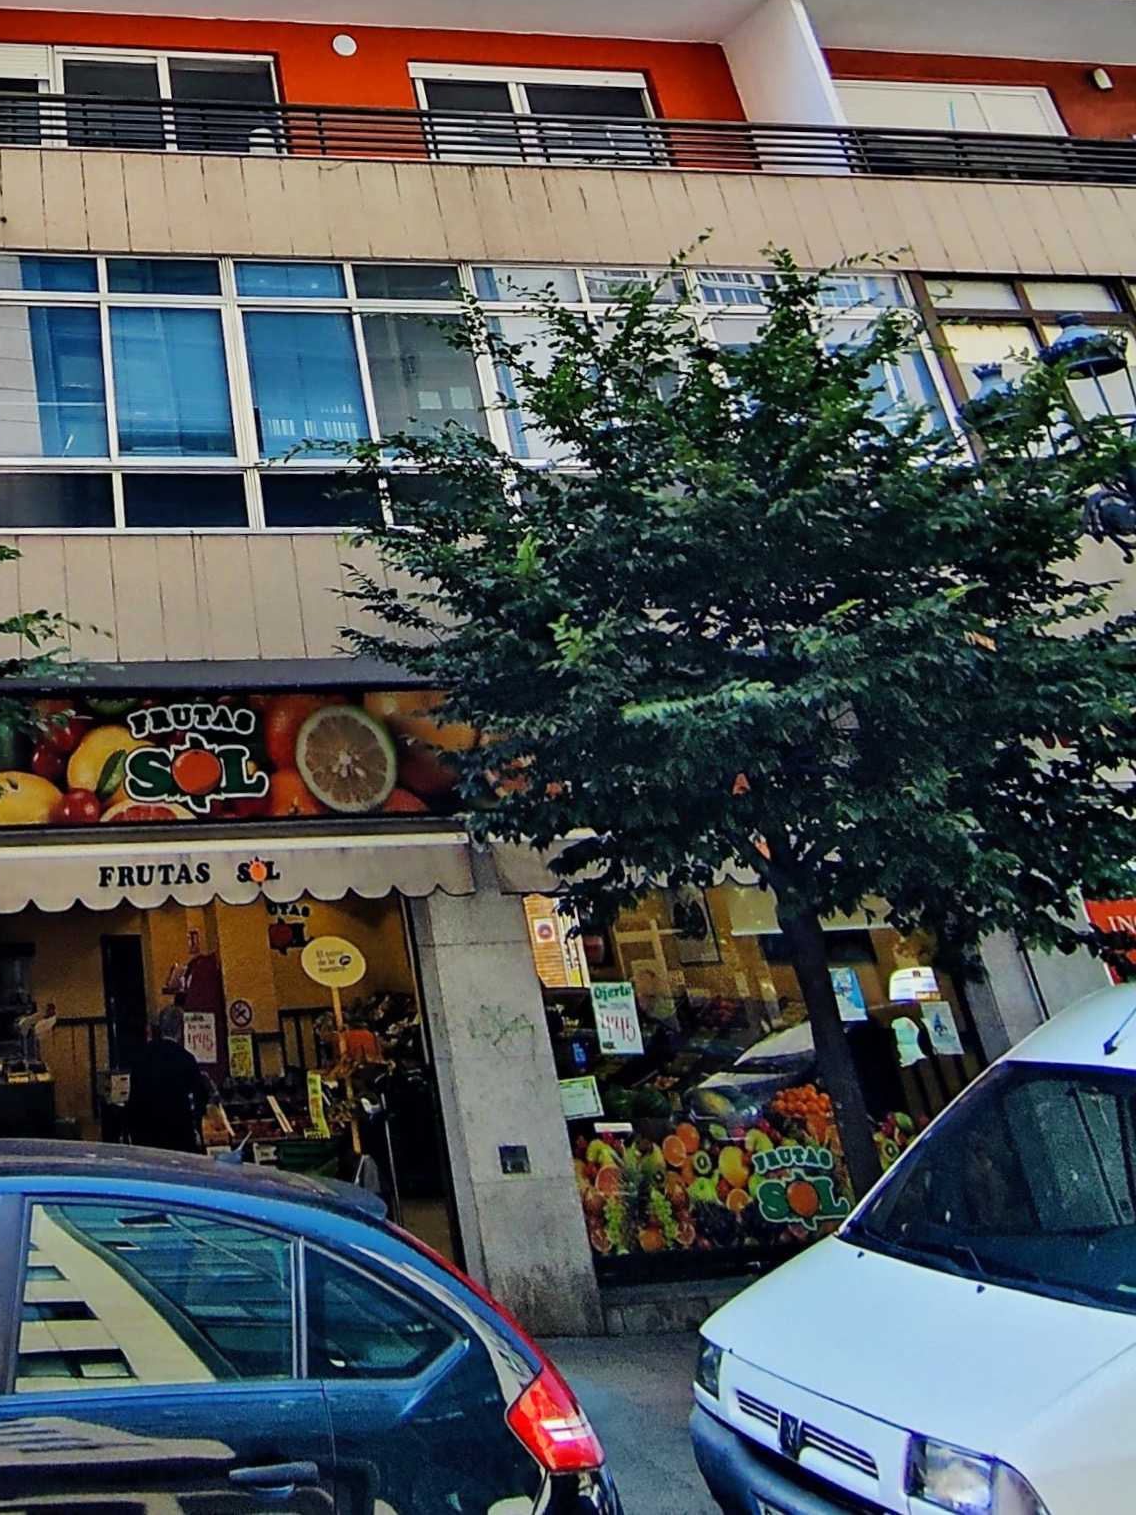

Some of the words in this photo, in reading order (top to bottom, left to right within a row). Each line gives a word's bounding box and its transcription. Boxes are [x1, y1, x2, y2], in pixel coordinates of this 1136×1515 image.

[127, 704, 255, 738] FRUTAS
[125, 736, 269, 811] SOL
[99, 863, 210, 887] FRUTAS
[237, 858, 281, 885] SOL
[267, 903, 310, 918] UTAS
[1107, 915, 1136, 935] IN
[752, 1146, 833, 1174] FRUTAS
[757, 1170, 850, 1228] SOL
